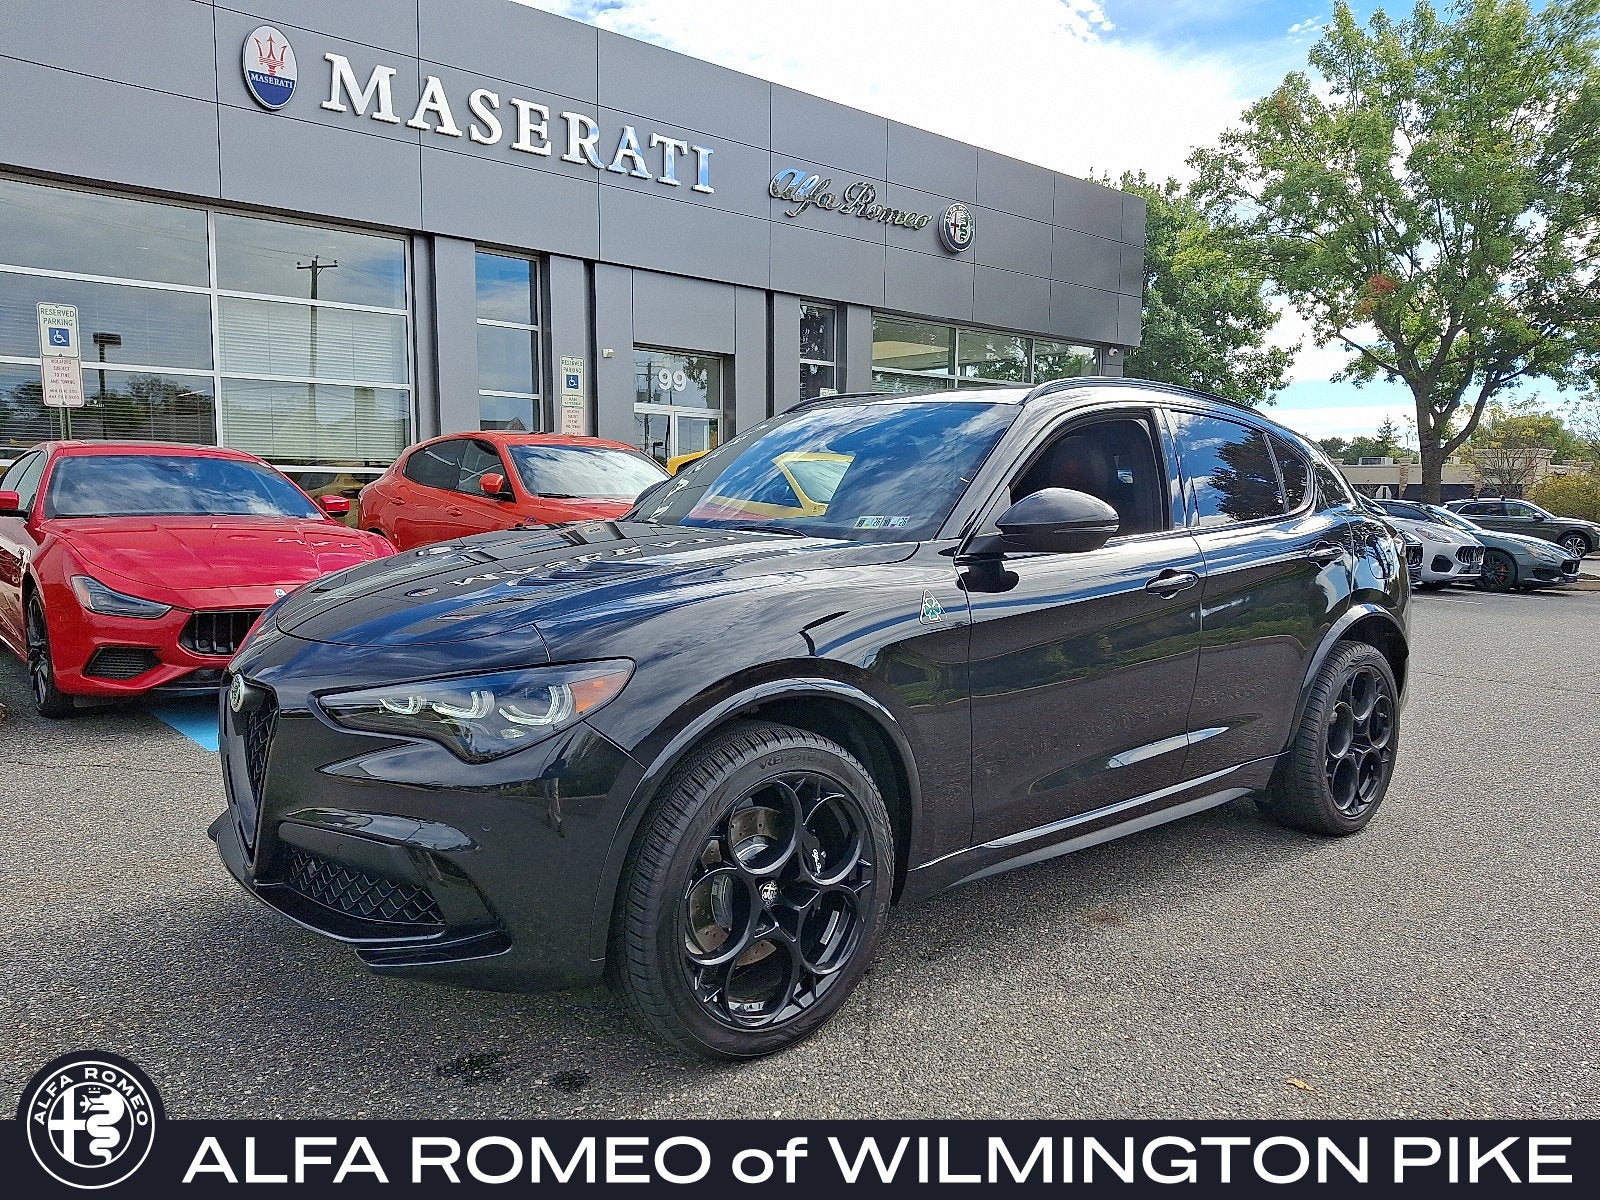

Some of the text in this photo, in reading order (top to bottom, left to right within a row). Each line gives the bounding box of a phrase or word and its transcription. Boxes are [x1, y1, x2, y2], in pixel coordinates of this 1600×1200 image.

[250, 72, 294, 89] MASERATI
[321, 52, 715, 194] MASERATI
[769, 168, 933, 230] Alfa Romeo
[40, 307, 75, 318] RESERVED
[43, 317, 73, 327] PARKING
[658, 368, 687, 392] 99
